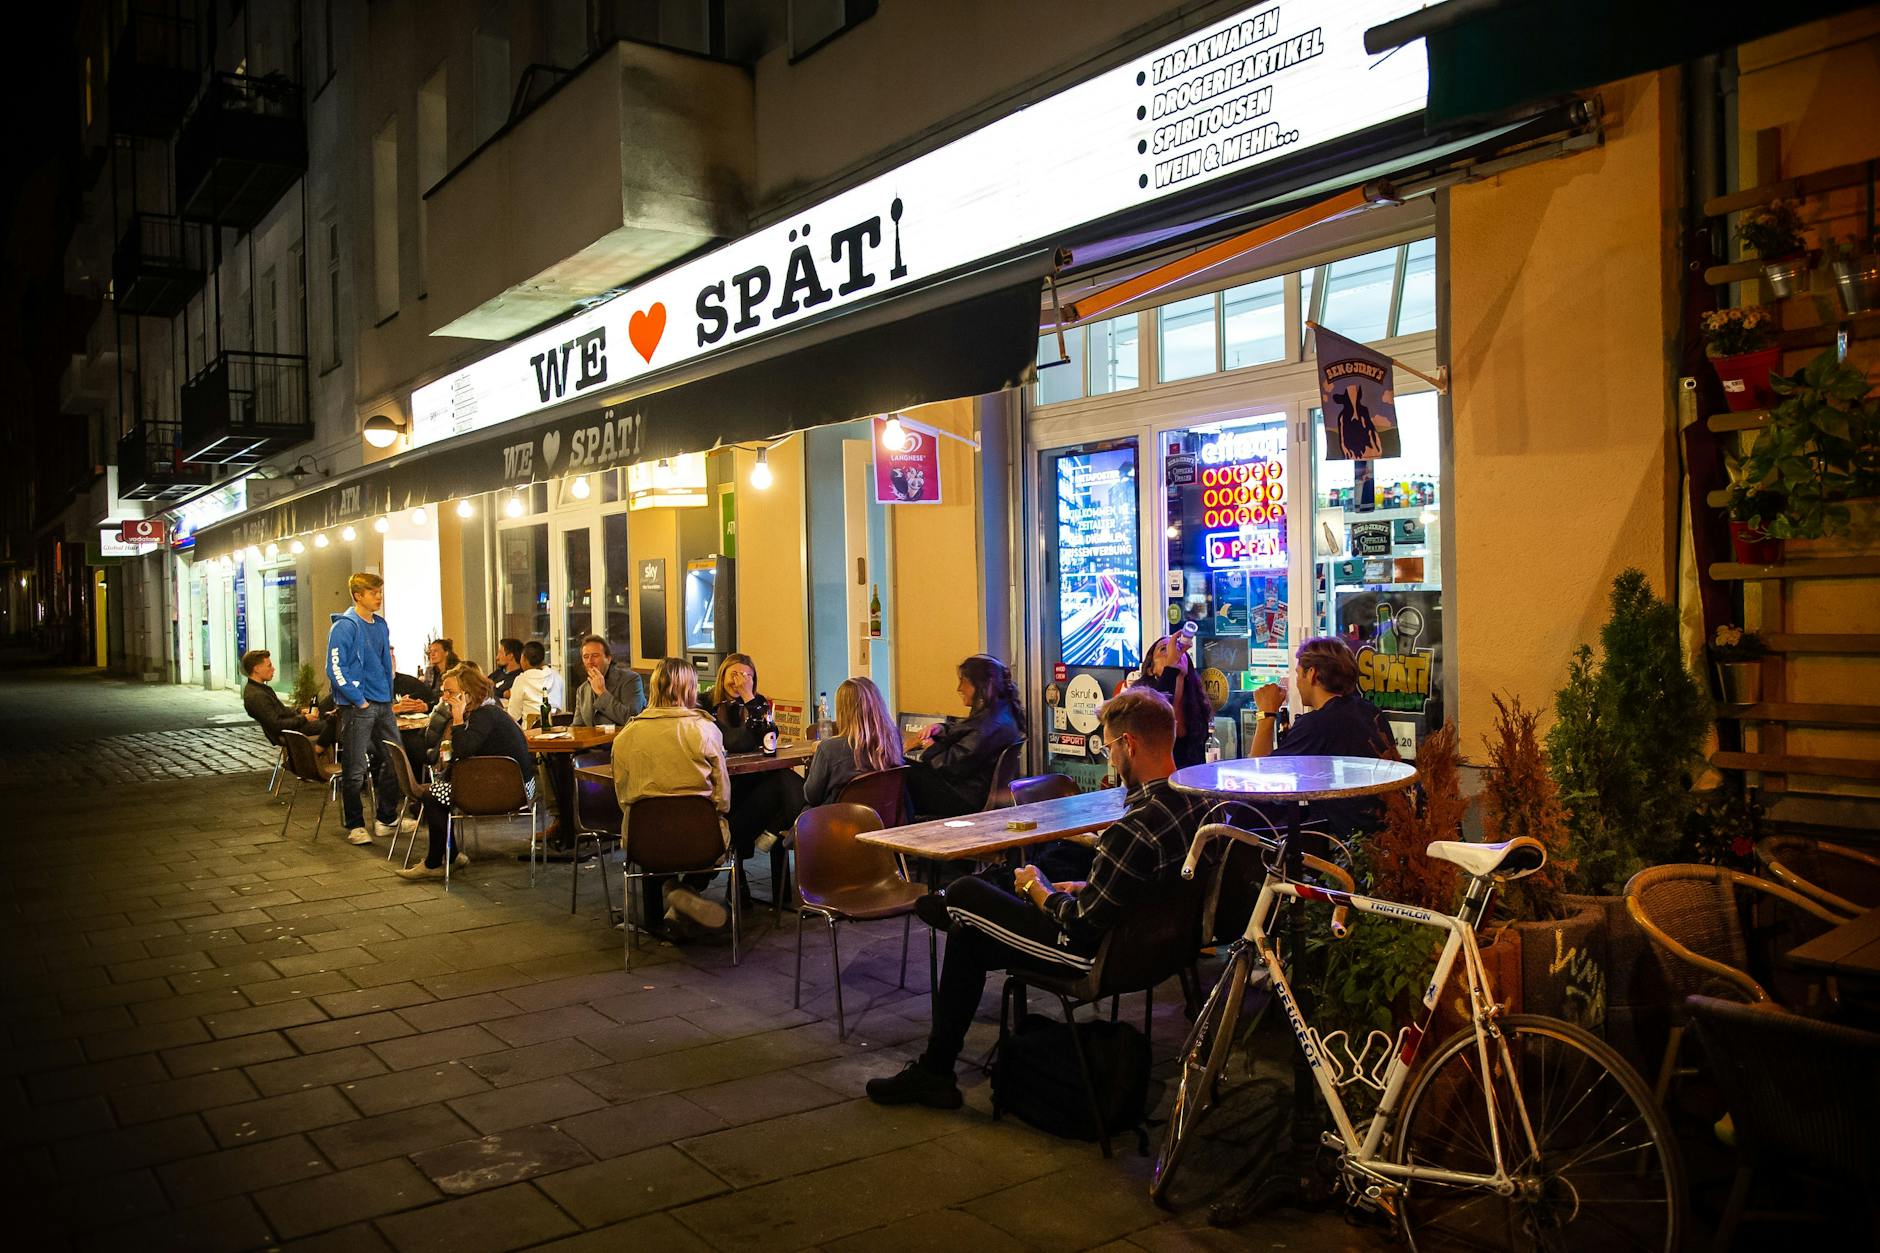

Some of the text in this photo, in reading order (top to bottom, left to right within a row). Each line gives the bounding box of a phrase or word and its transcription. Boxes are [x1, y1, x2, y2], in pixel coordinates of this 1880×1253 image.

[1152, 6, 1280, 86] TABAKWAREN
[1152, 27, 1324, 121] DROGERIEARTIKEL
[1152, 85, 1273, 154] SPIRITOUSEN
[1155, 149, 1202, 189] WEIN
[1204, 144, 1220, 172] &
[530, 326, 608, 403] WE
[503, 441, 534, 480] WE
[339, 485, 361, 516] ATM
[727, 520, 736, 535] AT
[1211, 536, 1279, 559] OPEN
[644, 562, 658, 580] sky
[1071, 688, 1091, 699] skruf
[1061, 736, 1084, 746] SPORT
[1371, 903, 1431, 920] TRIATHLON
[1275, 981, 1321, 1067] PEUGEOT
